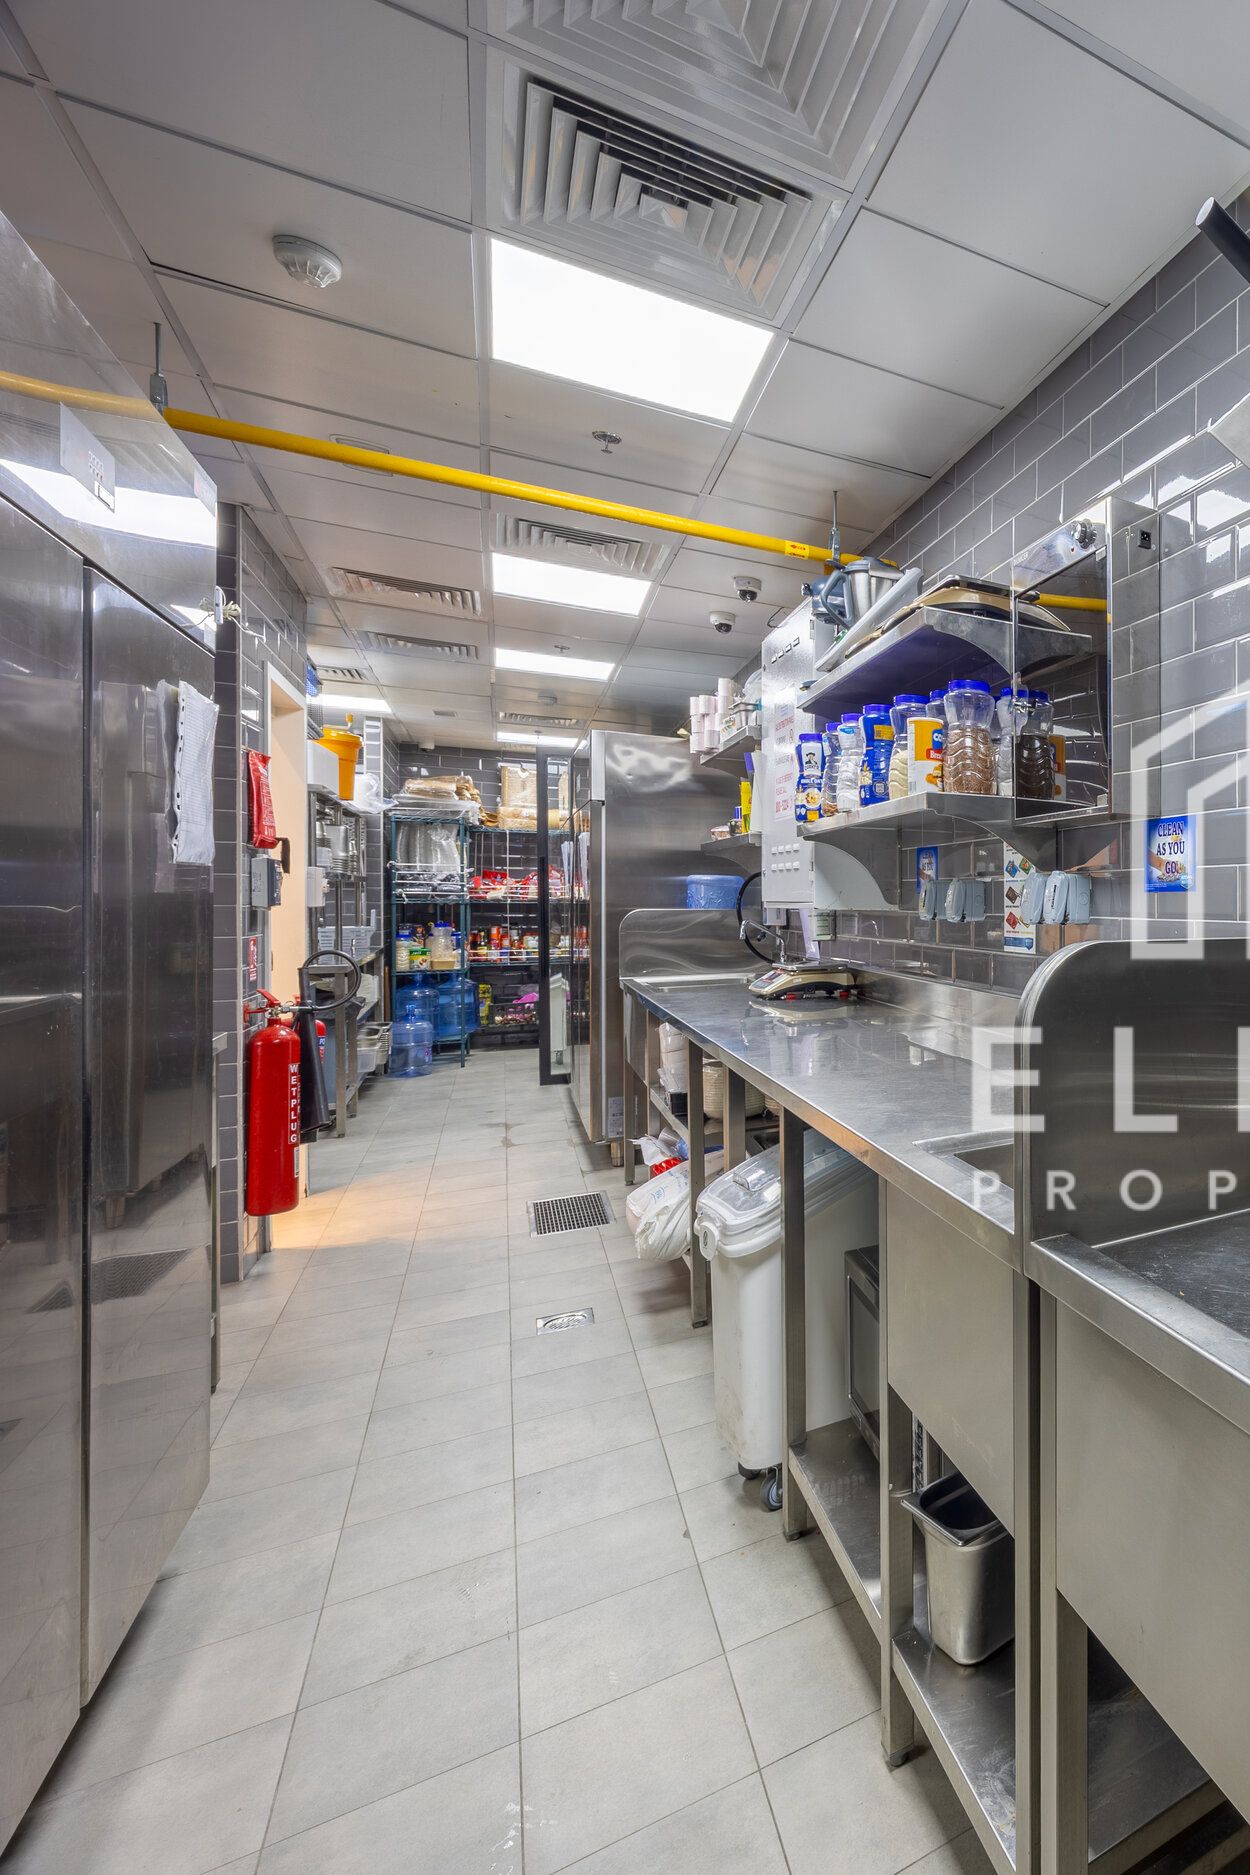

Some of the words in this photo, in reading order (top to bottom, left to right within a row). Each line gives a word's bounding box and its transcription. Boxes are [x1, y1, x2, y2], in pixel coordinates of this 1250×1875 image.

[1157, 821, 1184, 837] CLEAN
[1156, 842, 1166, 855] AS
[1168, 841, 1185, 855] YOU
[1165, 861, 1176, 874] GO
